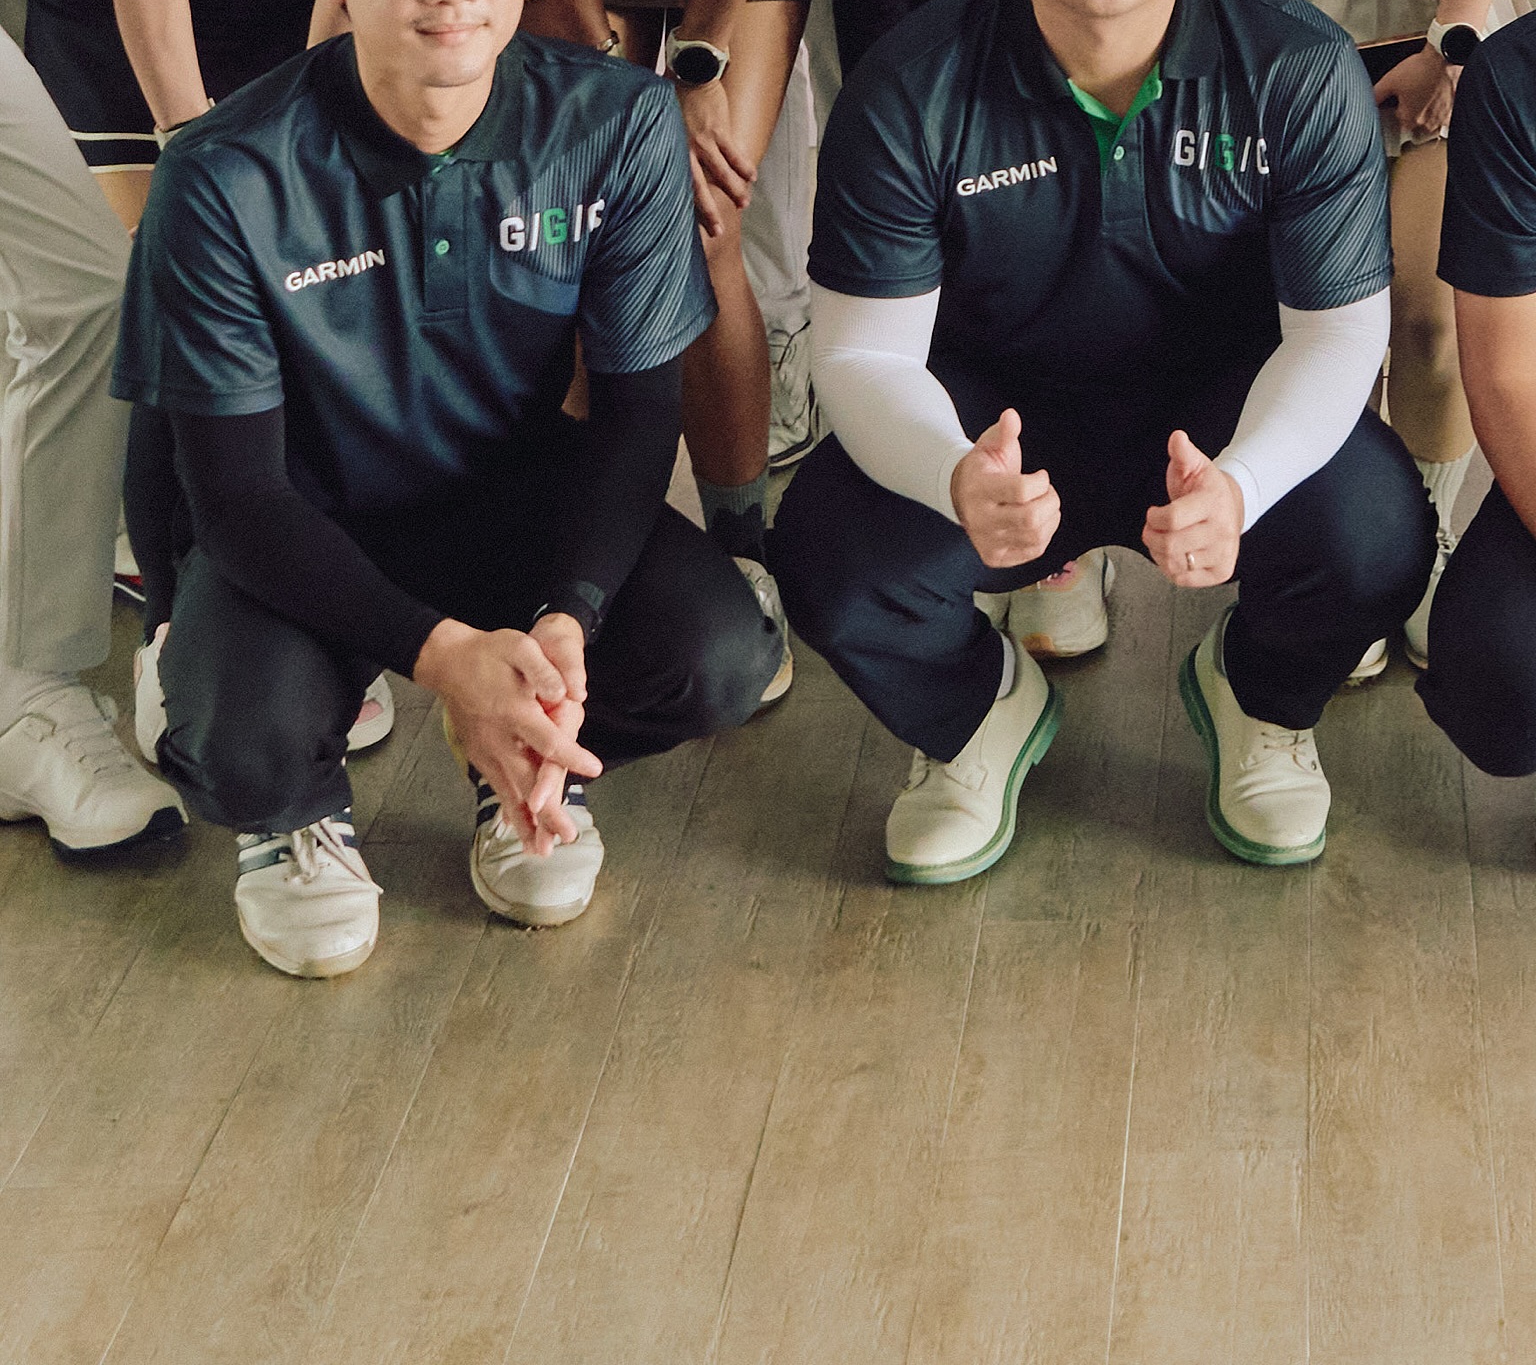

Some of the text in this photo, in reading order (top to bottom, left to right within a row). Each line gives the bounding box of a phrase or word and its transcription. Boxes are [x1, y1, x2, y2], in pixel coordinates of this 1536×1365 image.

[1173, 128, 1271, 176] G/G/C
[955, 156, 1059, 198] GARMIN
[284, 248, 386, 293] GARMIN
